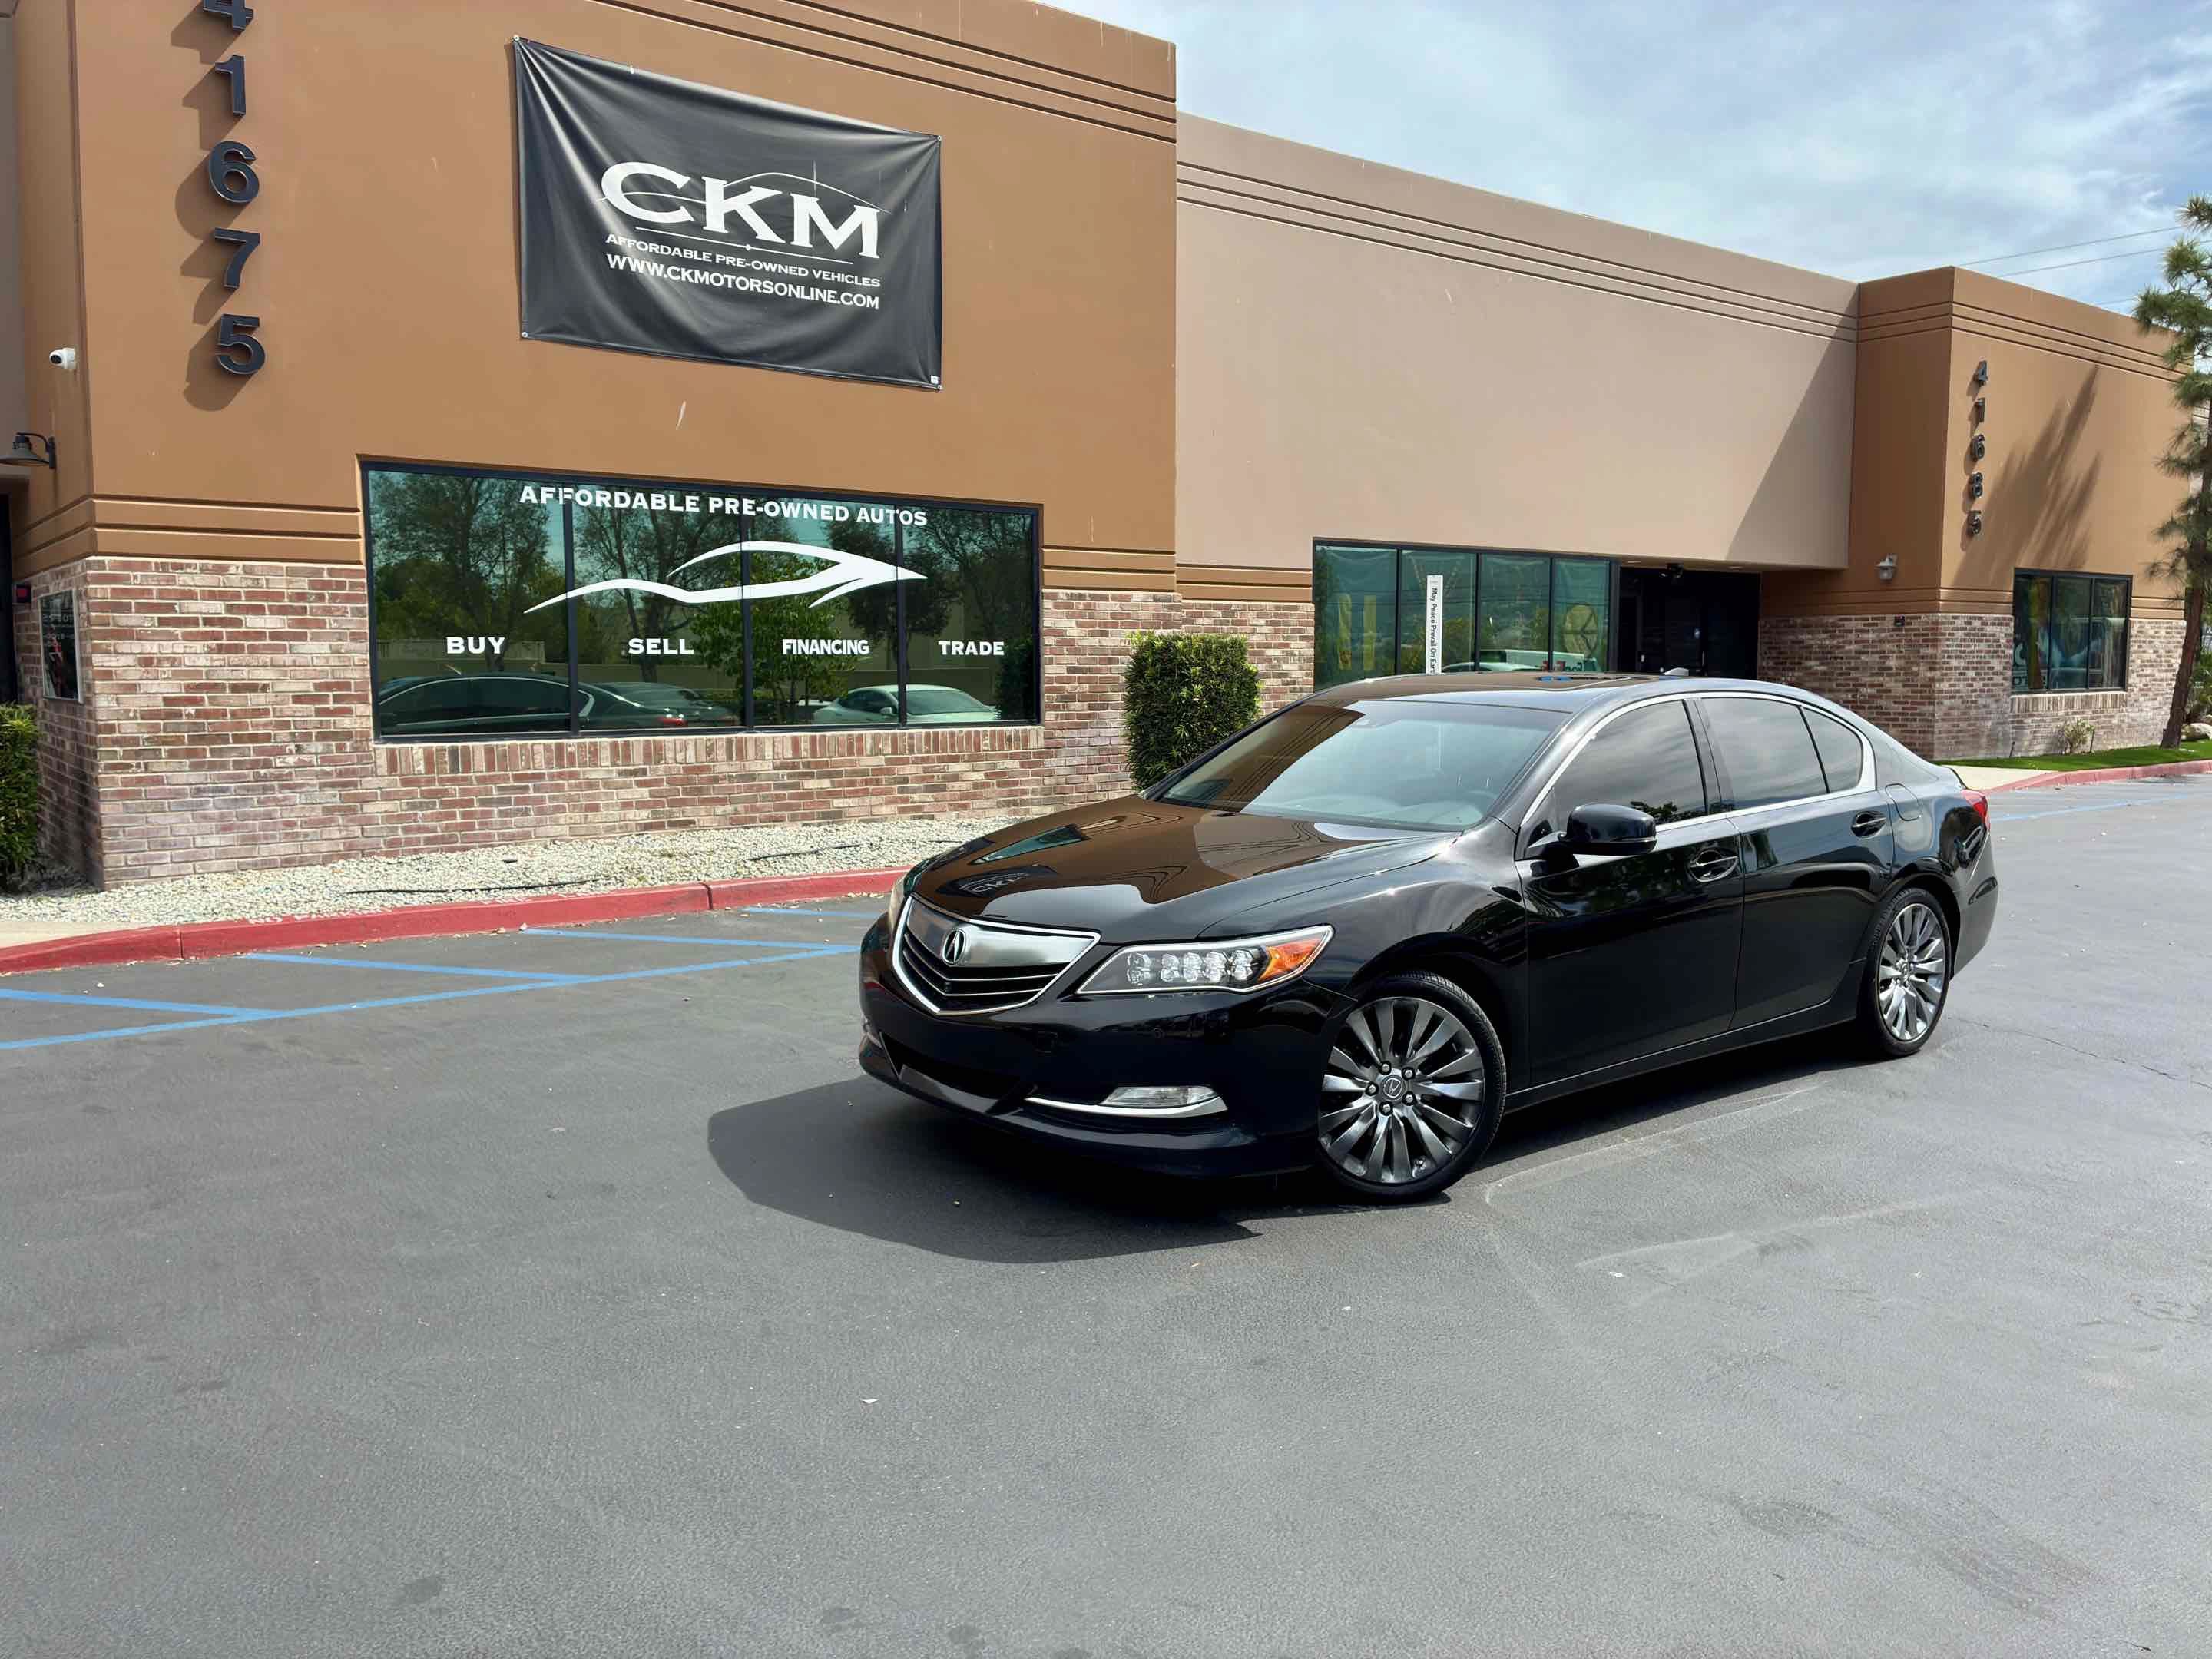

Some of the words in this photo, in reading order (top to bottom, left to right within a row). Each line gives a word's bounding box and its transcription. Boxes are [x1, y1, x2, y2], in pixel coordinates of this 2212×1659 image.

[601, 161, 880, 258] CKM
[605, 233, 713, 262] AFFORDABLE
[715, 253, 809, 277] PRE-OWNED
[811, 269, 881, 287] VEHICLES
[606, 253, 880, 310] WWW.CKMOTORSONLINE.COM
[1967, 359, 1988, 535] 41685
[519, 485, 700, 512] AFFORDABLE
[708, 497, 849, 522] PRE-OWNED
[856, 507, 928, 526] AUTOS
[446, 637, 505, 654] BUY
[628, 638, 695, 655] SELL
[782, 639, 870, 655] FINANCING
[938, 641, 1005, 656] TRADE
[1430, 647, 1437, 657] On
